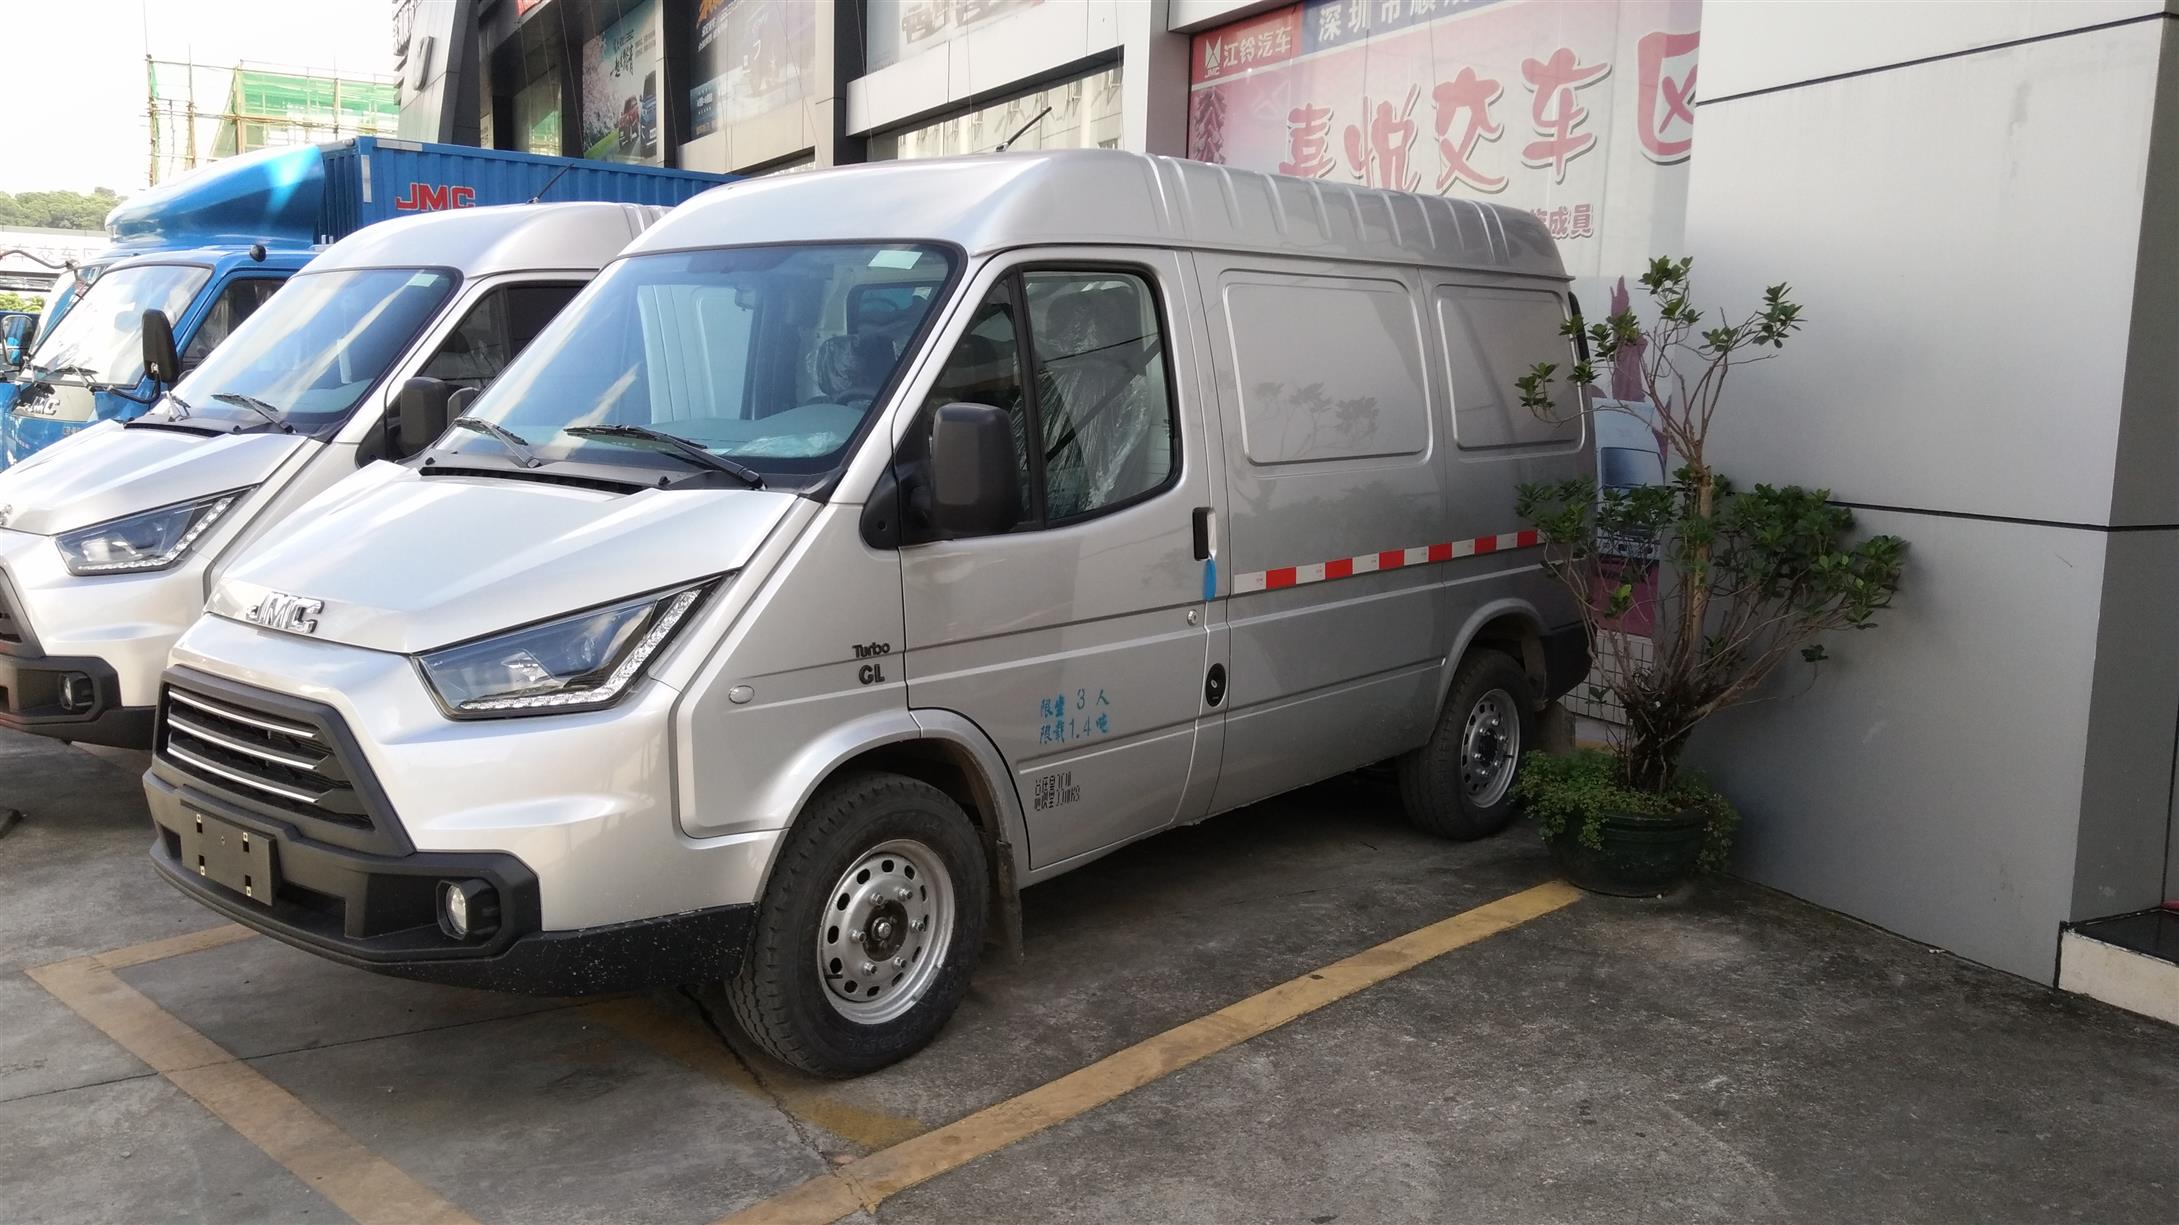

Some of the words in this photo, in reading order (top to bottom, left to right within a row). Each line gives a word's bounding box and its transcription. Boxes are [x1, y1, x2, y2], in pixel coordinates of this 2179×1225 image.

[1223, 26, 1292, 67] 江铃汽车
[395, 183, 475, 212] JMC
[246, 592, 325, 634] JMC
[852, 642, 891, 658] Turbo
[859, 664, 886, 685] GL
